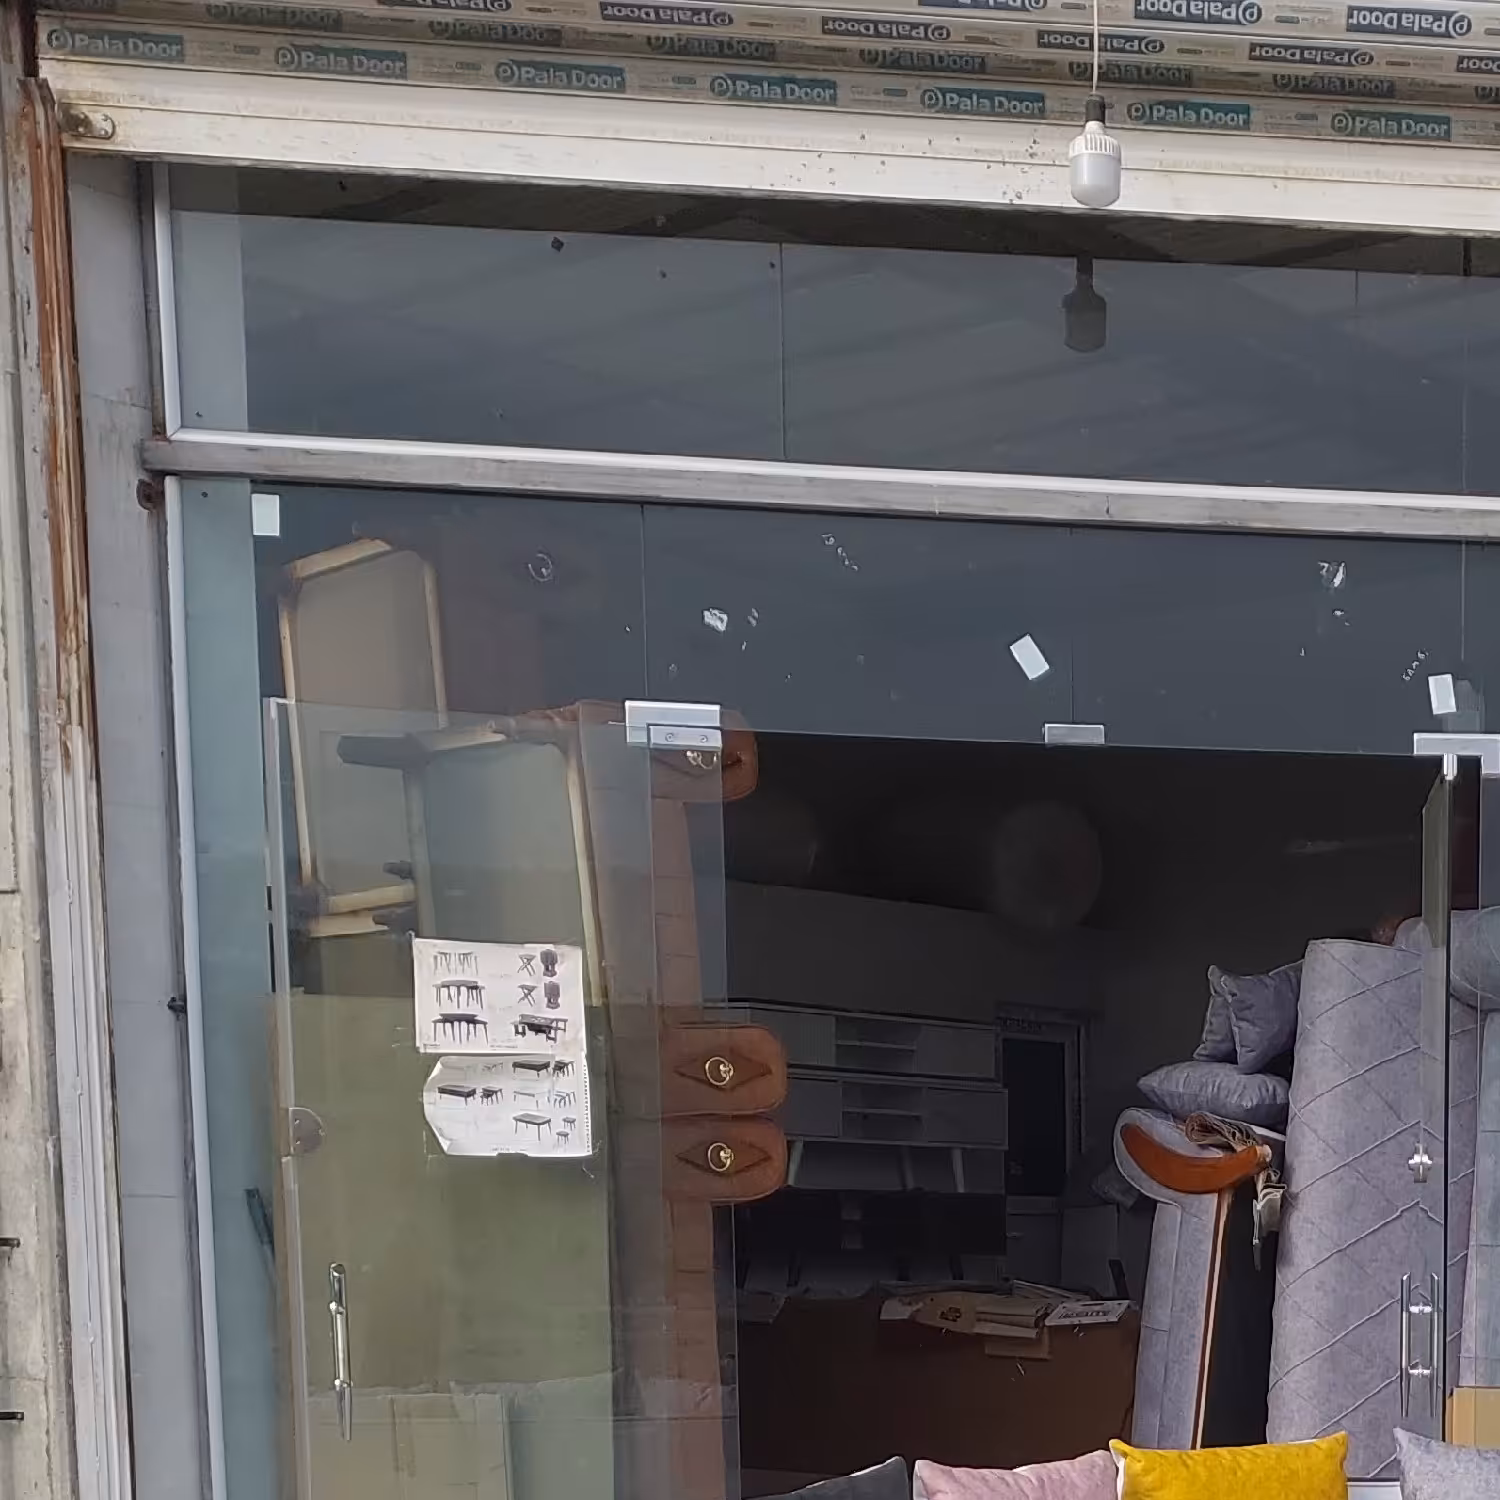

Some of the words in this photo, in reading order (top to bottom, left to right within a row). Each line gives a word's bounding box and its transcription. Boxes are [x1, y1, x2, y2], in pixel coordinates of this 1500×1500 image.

[604, 6, 656, 20] Door
[659, 8, 707, 24] Pala
[1137, 0, 1186, 17] Door
[1190, 0, 1236, 20] Pala
[825, 20, 874, 35] Door
[1348, 9, 1397, 30] Door
[1401, 13, 1446, 32] Pala
[878, 23, 924, 39] Pala
[1040, 33, 1090, 48] Door
[75, 33, 123, 50] Pala
[129, 38, 181, 56] Door
[1251, 46, 1300, 61] Door
[301, 50, 348, 70] Pala
[353, 55, 406, 74] Door
[1304, 48, 1349, 63] Pala
[521, 66, 567, 85] Pala
[572, 70, 622, 89] Door
[735, 80, 782, 98] Pala
[786, 83, 834, 101] Door
[945, 92, 991, 110] Pala
[995, 97, 1042, 114] Door
[1152, 104, 1196, 122] Pala
[1201, 108, 1246, 126] Door
[1354, 116, 1398, 134] Pala
[1402, 119, 1447, 137] Door
